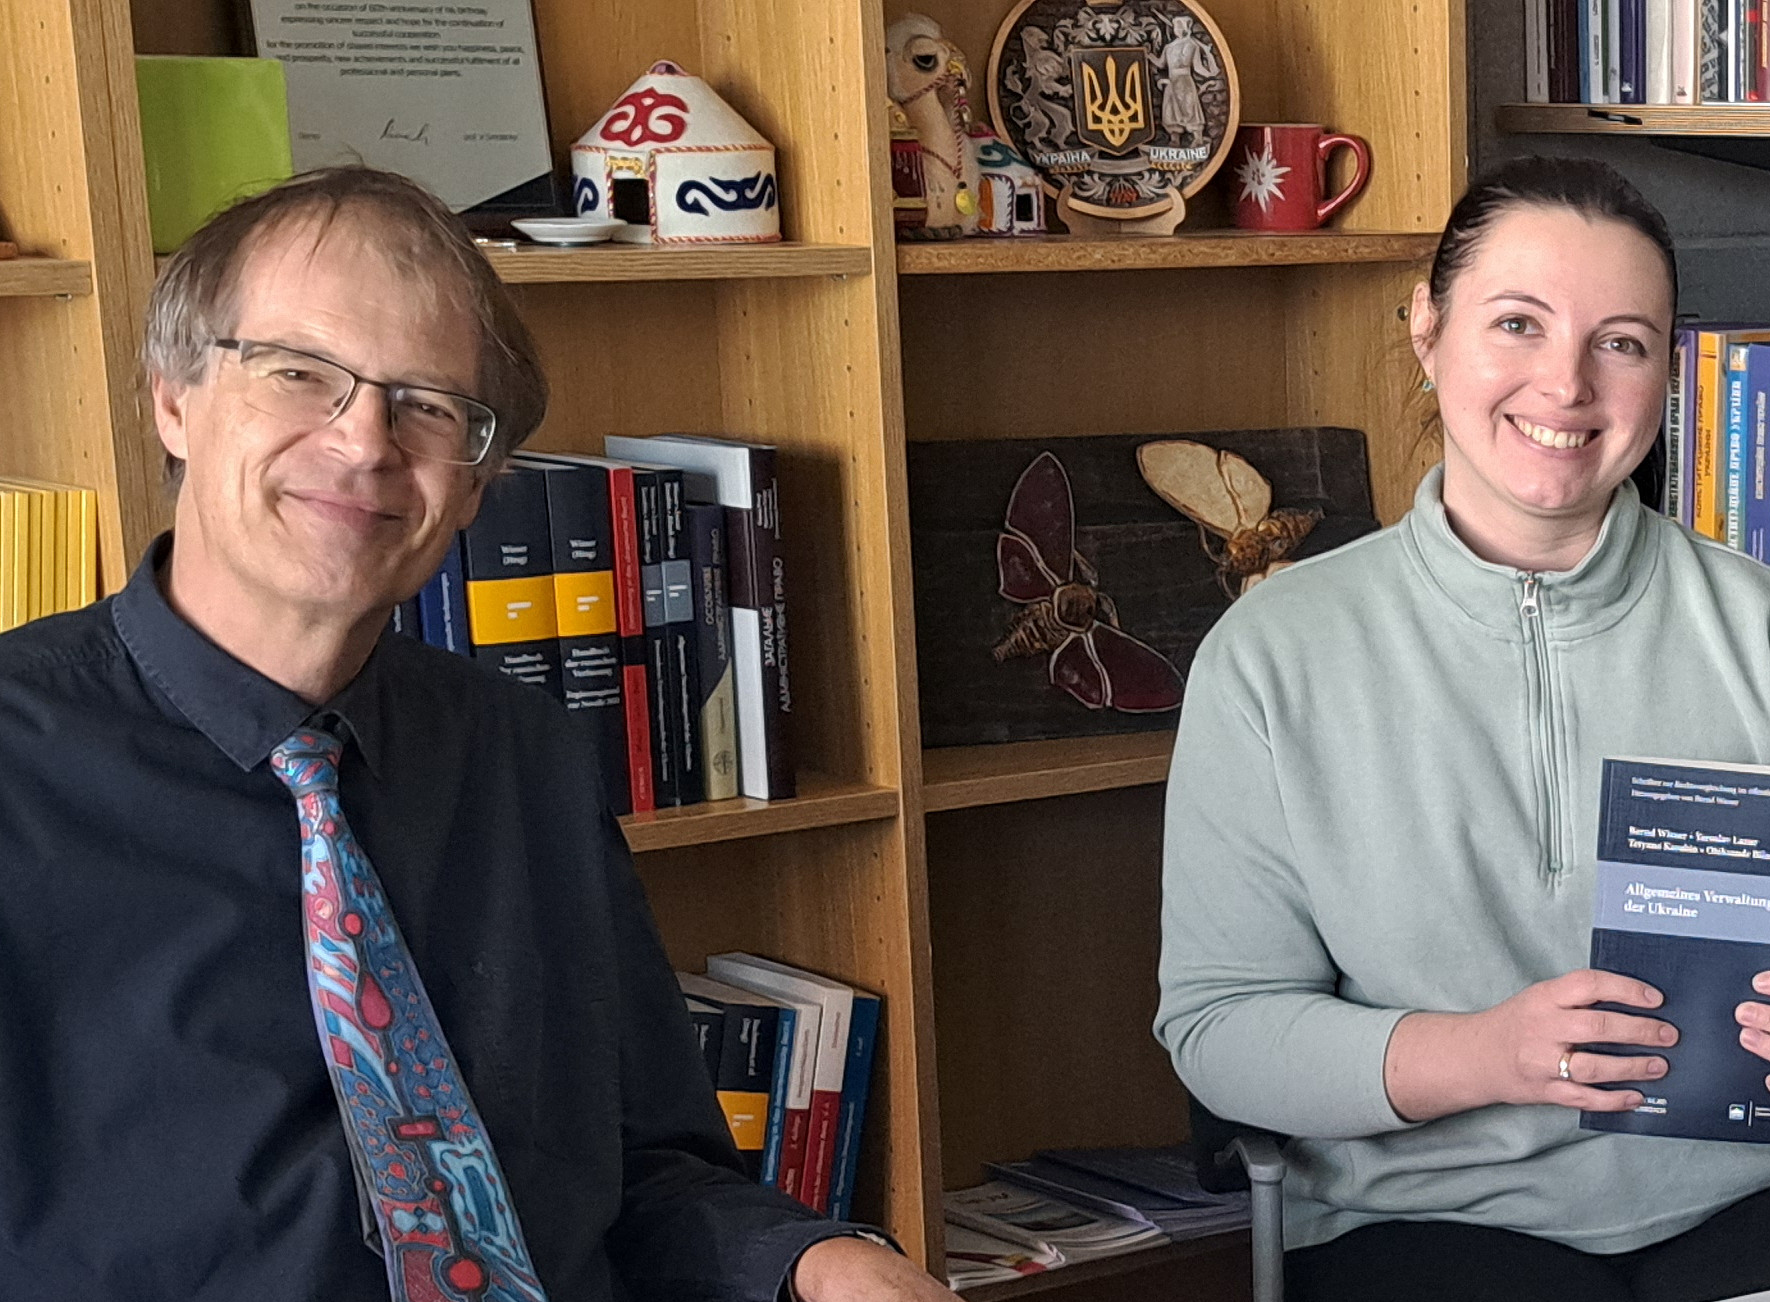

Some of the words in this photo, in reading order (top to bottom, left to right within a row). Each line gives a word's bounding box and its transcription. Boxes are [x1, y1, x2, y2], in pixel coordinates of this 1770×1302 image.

[1150, 147, 1208, 162] UKRAINE
[772, 556, 785, 601] ПРАВО
[1629, 826, 1655, 837] Bernd
[1625, 883, 1700, 902] Allgemeines
[1624, 900, 1646, 913] der
[1648, 902, 1699, 917] Ukraine
